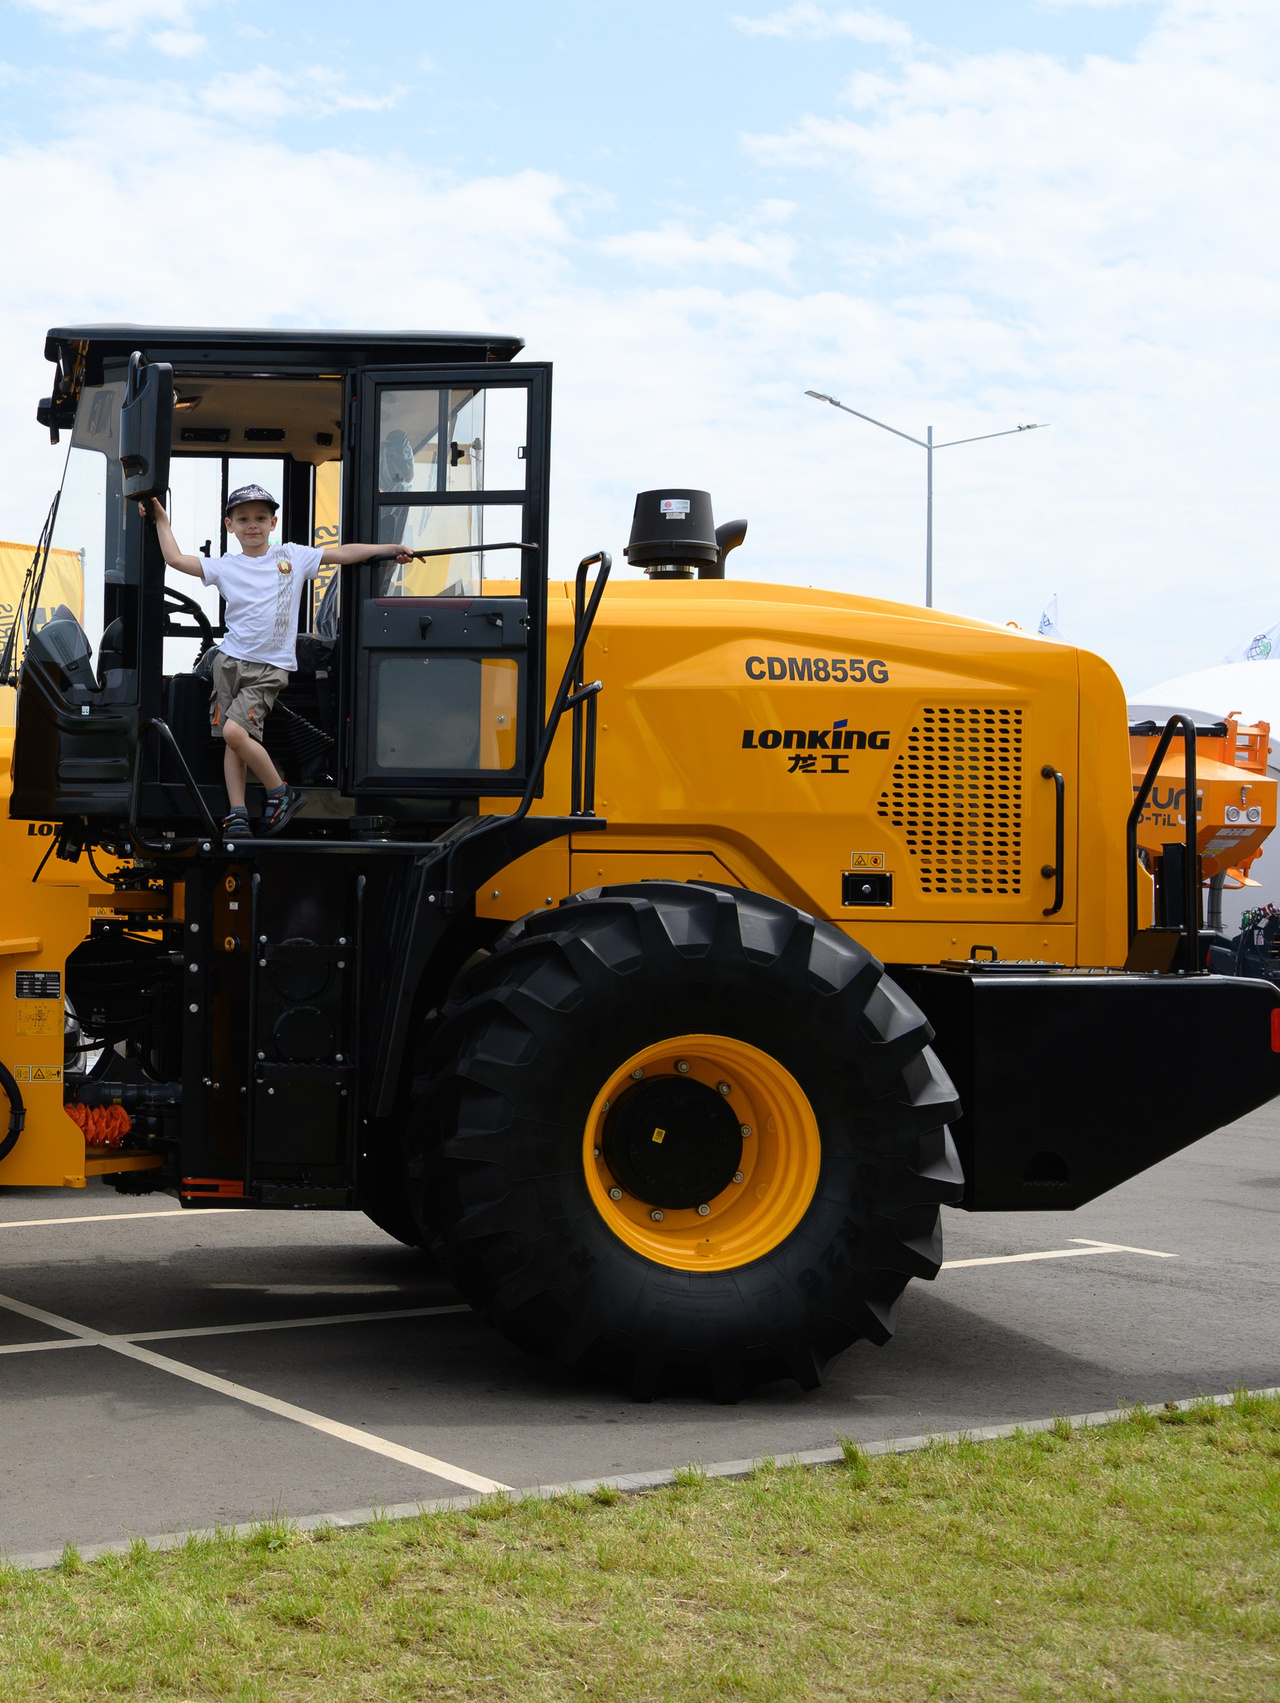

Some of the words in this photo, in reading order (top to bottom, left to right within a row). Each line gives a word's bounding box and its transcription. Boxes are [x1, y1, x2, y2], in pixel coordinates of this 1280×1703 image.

[745, 656, 889, 684] CDM855G
[742, 718, 890, 750] LONKING
[787, 754, 849, 774] 龙工
